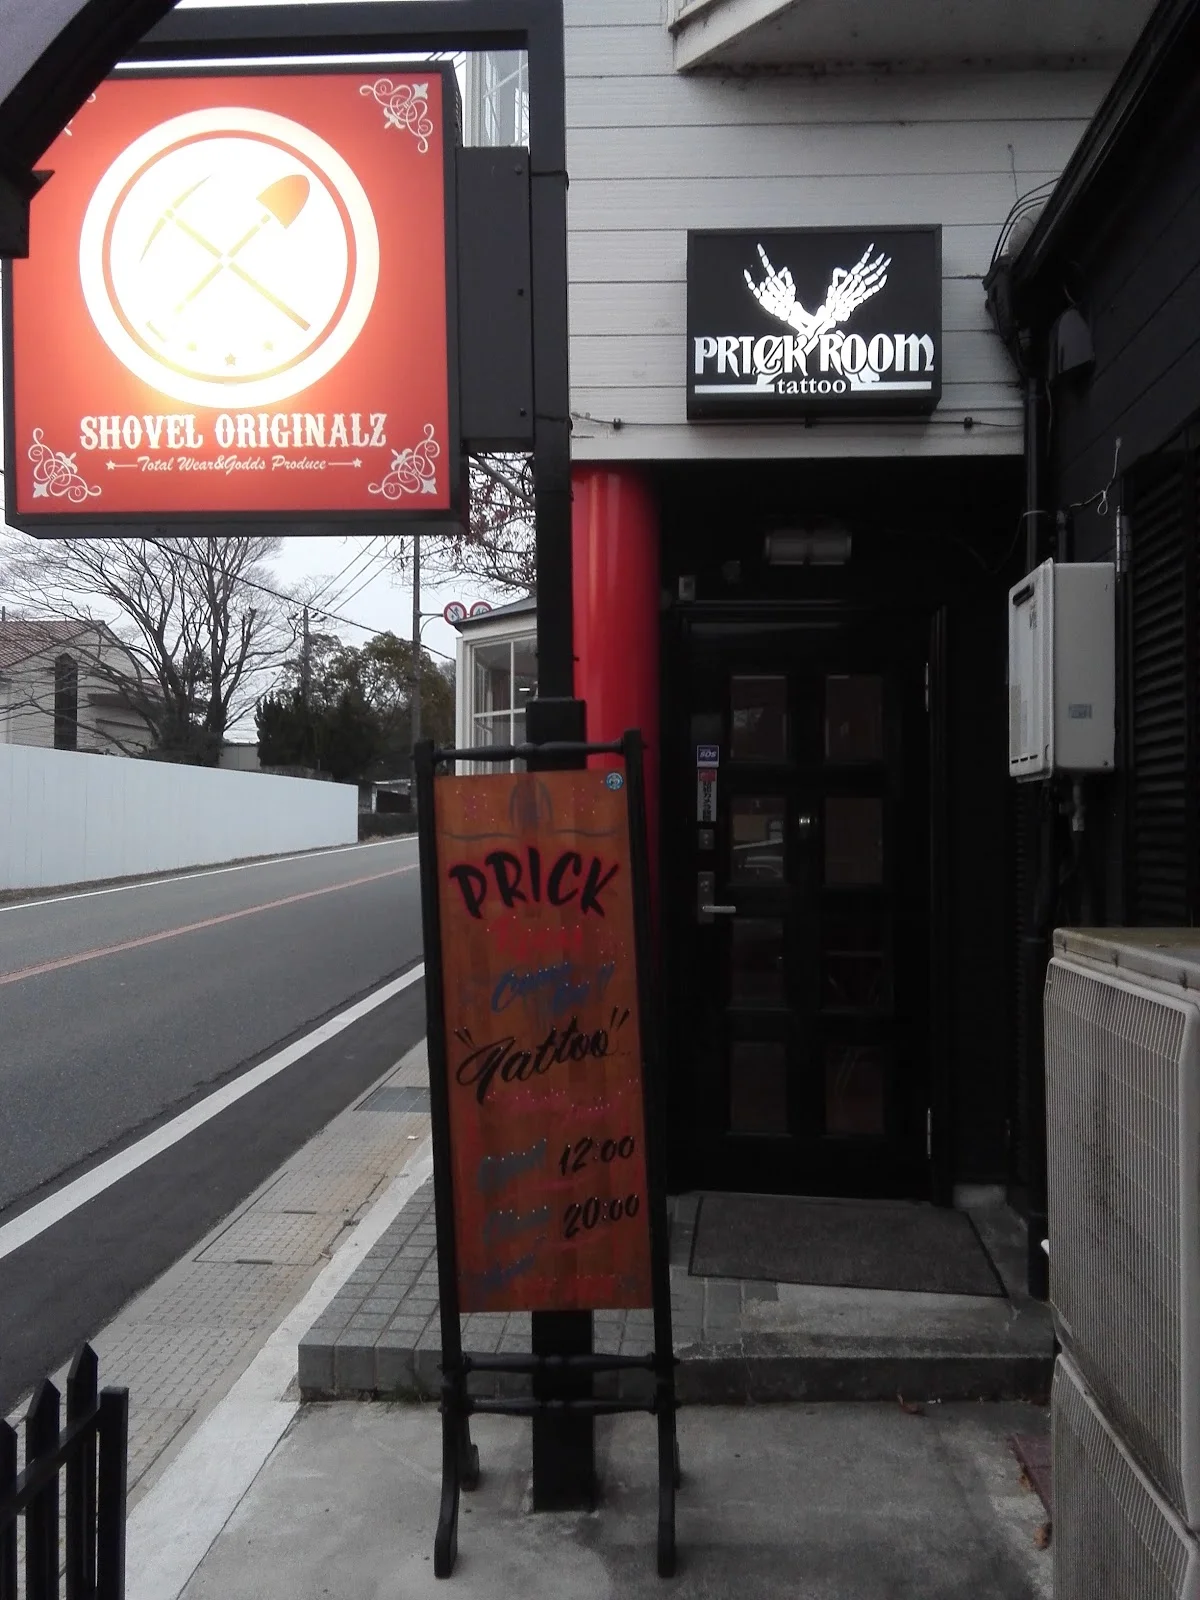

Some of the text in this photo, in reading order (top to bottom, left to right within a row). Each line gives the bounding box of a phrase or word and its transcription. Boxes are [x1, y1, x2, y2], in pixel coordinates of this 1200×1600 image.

[694, 333, 935, 378] PRICK ROOM
[778, 379, 847, 394] tattoo
[80, 412, 388, 451] SHOVEL ORIGINALZ
[137, 455, 175, 472] Total
[271, 454, 327, 472] Produce
[448, 846, 619, 919] PRICK
[558, 1136, 635, 1176] 12:00
[563, 1194, 640, 1240] 20:00
